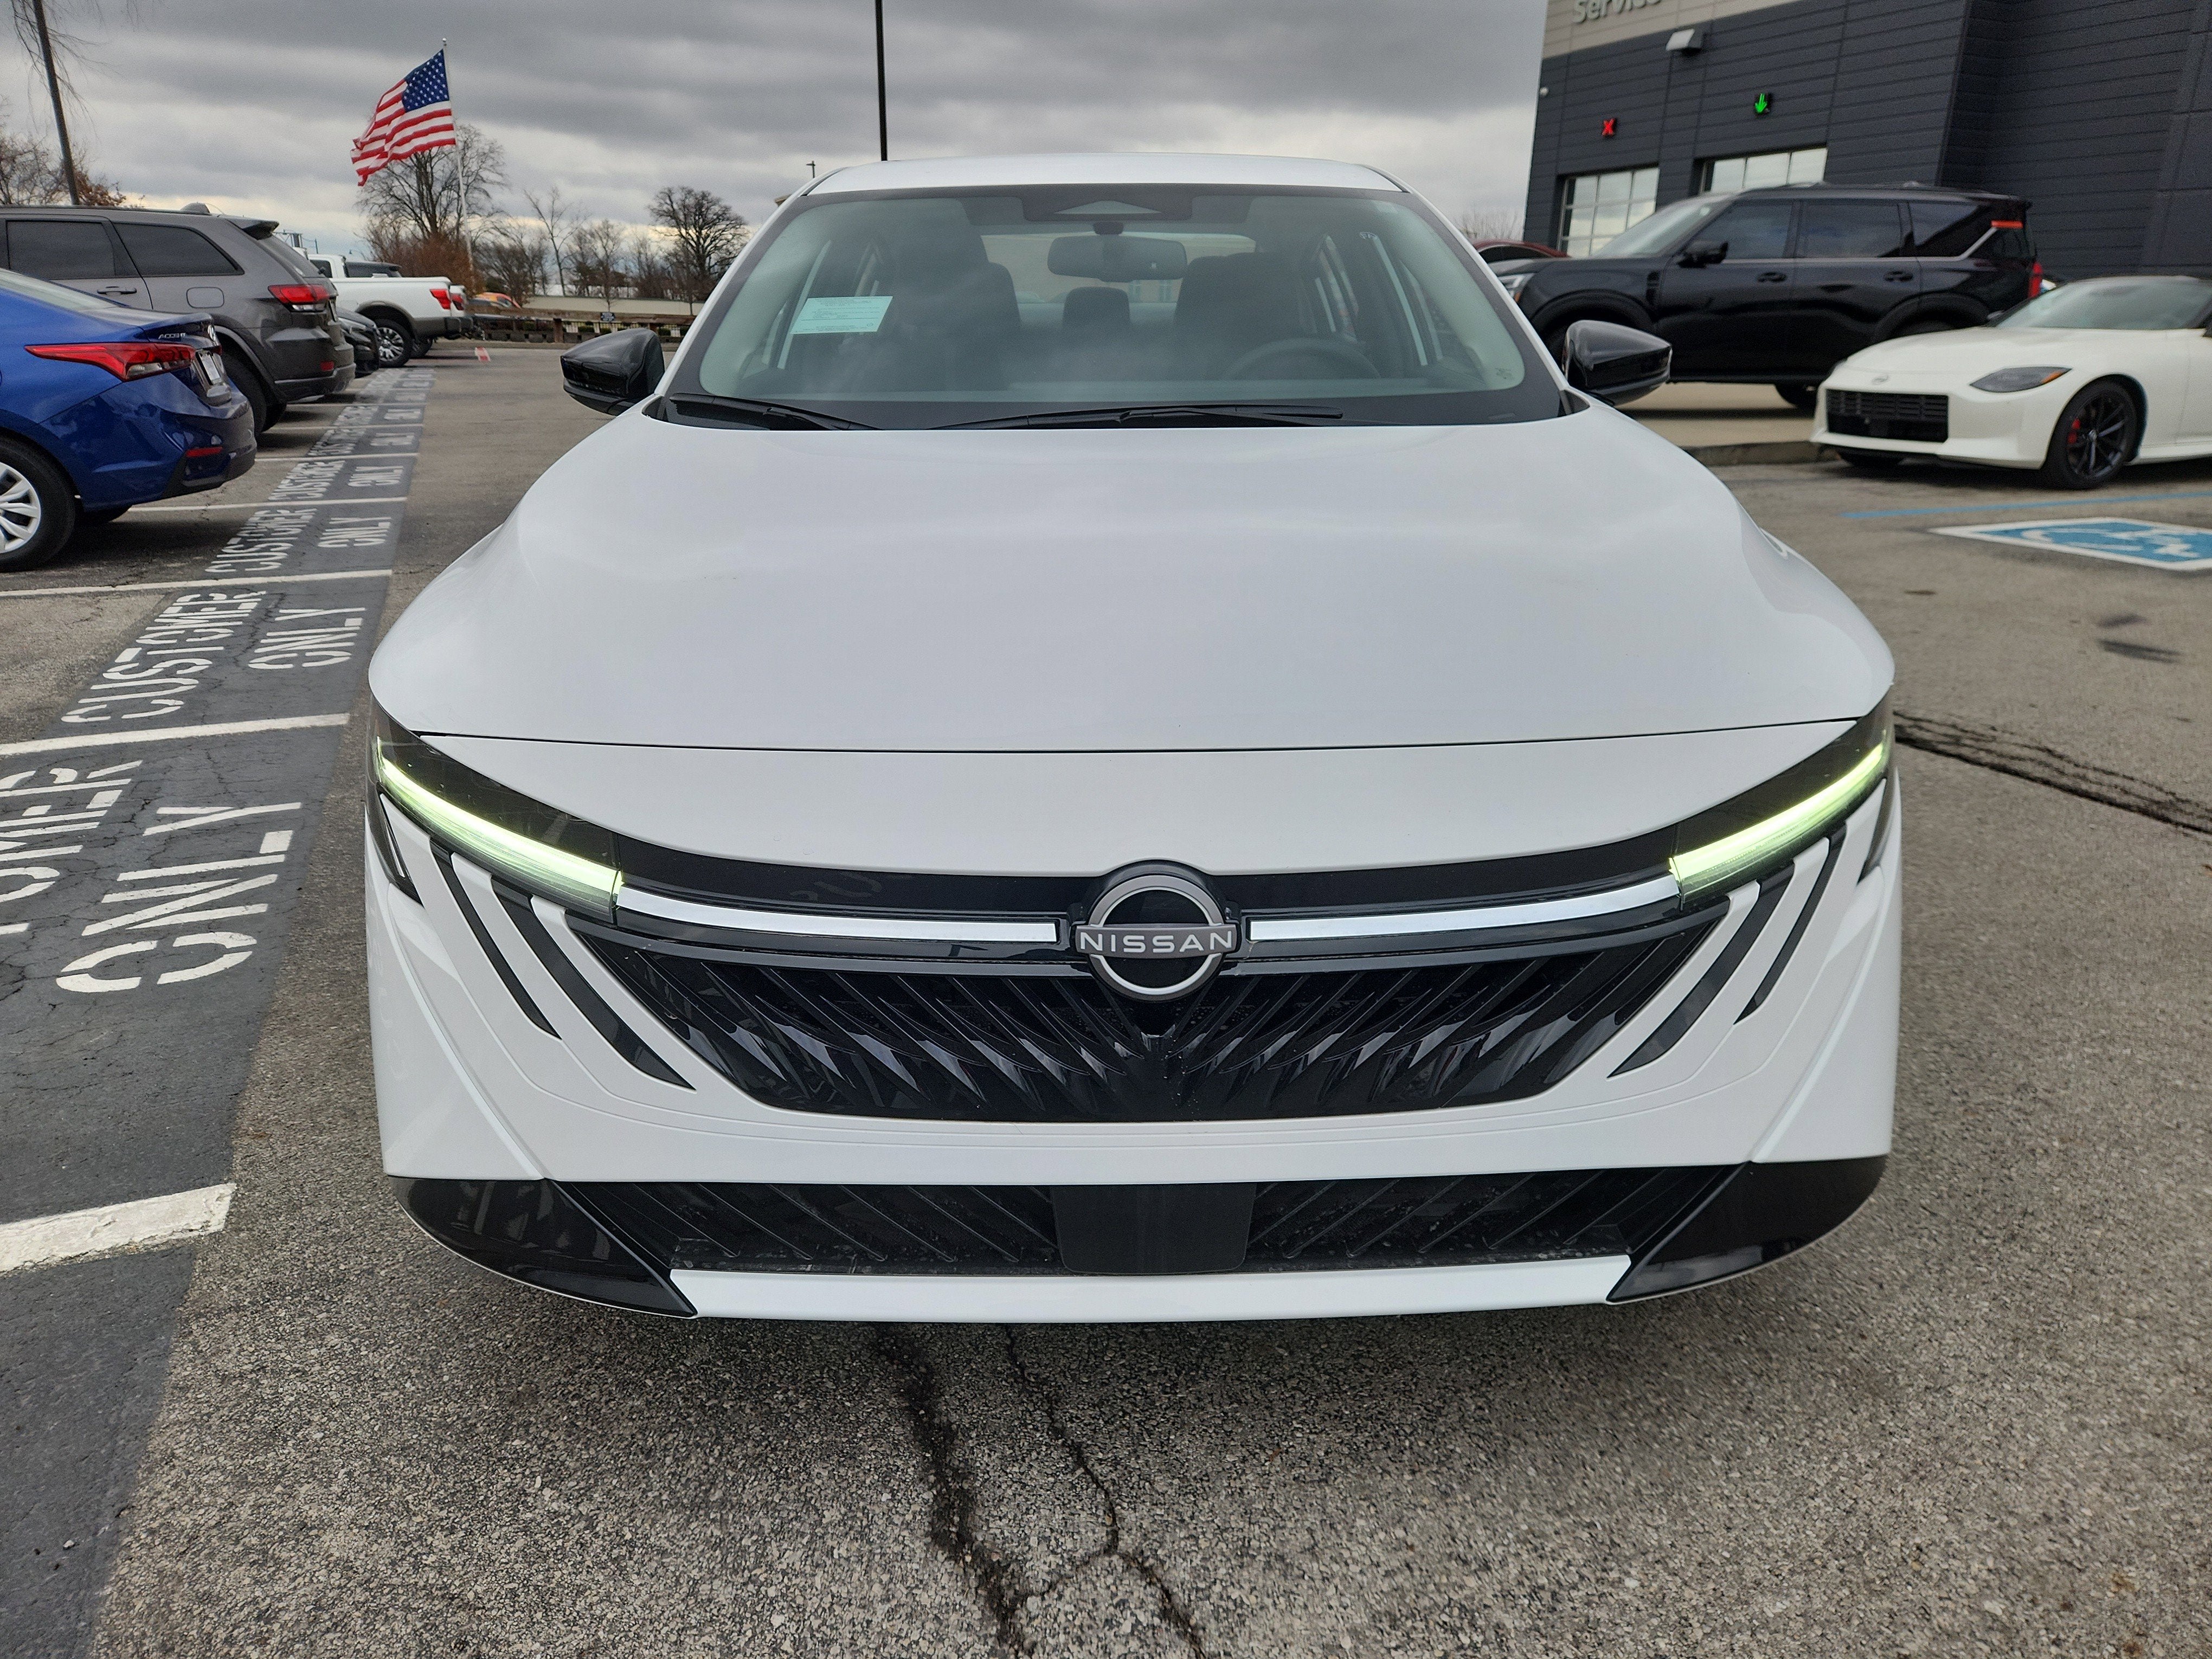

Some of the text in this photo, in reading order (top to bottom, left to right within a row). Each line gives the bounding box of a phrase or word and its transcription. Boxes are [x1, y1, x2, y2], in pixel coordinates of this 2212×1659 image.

[1572, 0, 1660, 23] Servi
[205, 509, 317, 573] CUSTOMER
[318, 517, 391, 548] ONLY
[61, 590, 267, 723] CUSTOMER
[248, 607, 365, 670] ONLY
[56, 802, 302, 993] ONLY
[1080, 931, 1232, 953] NISSAN
